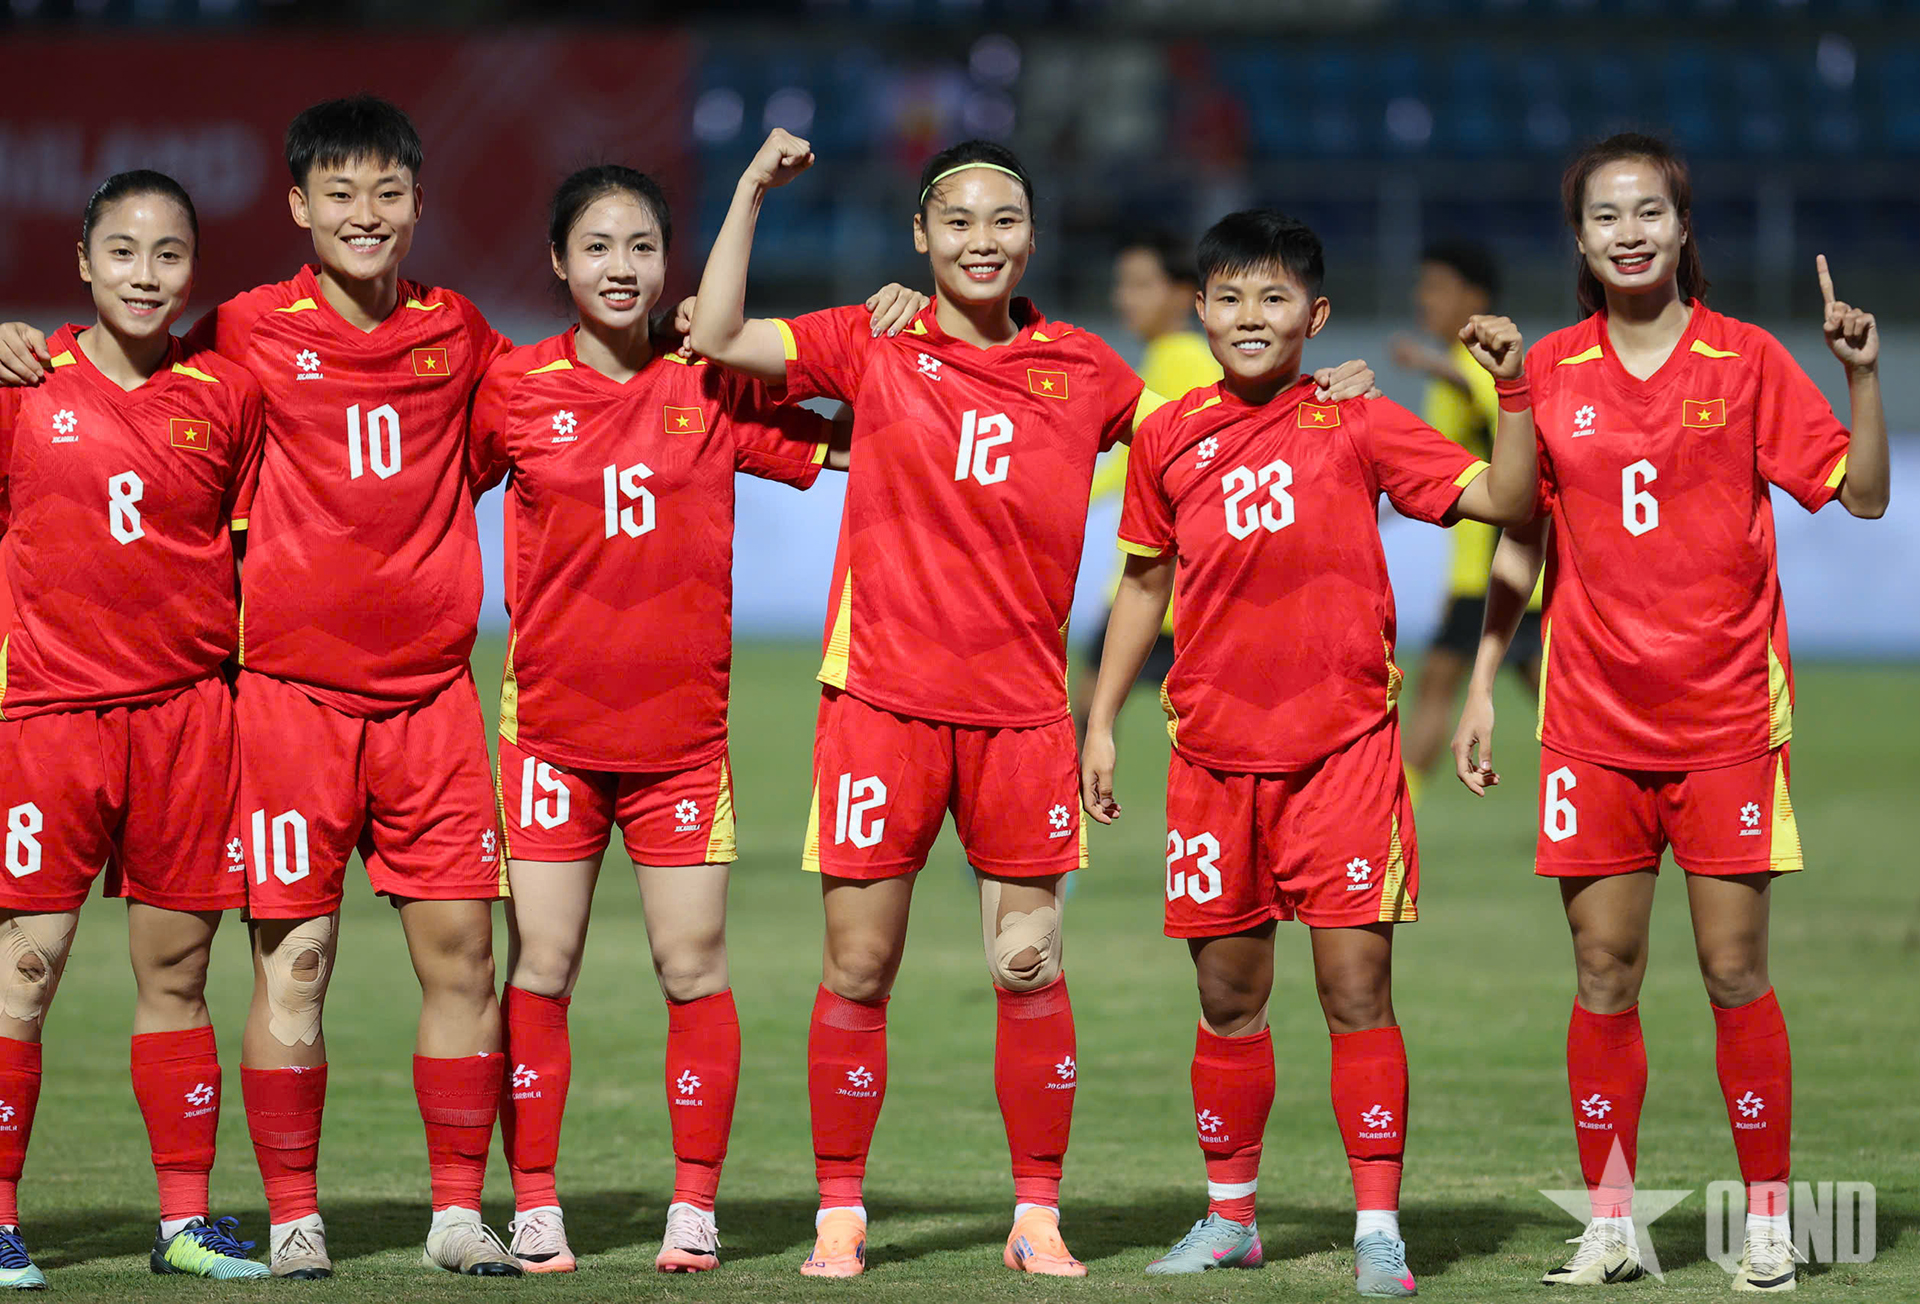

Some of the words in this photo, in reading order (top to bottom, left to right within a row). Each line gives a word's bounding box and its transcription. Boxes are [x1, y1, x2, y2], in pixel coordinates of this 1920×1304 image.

[346, 404, 402, 480] 10
[955, 410, 1014, 486] 12
[108, 471, 146, 545] 8
[603, 463, 656, 539] 15
[1221, 458, 1296, 541] 23
[1621, 459, 1659, 537] 6
[520, 755, 571, 830] 15
[834, 772, 888, 849] 12
[1543, 766, 1578, 843] 6
[4, 801, 44, 879] 8
[251, 808, 310, 886] 10
[1166, 828, 1223, 905] 23
